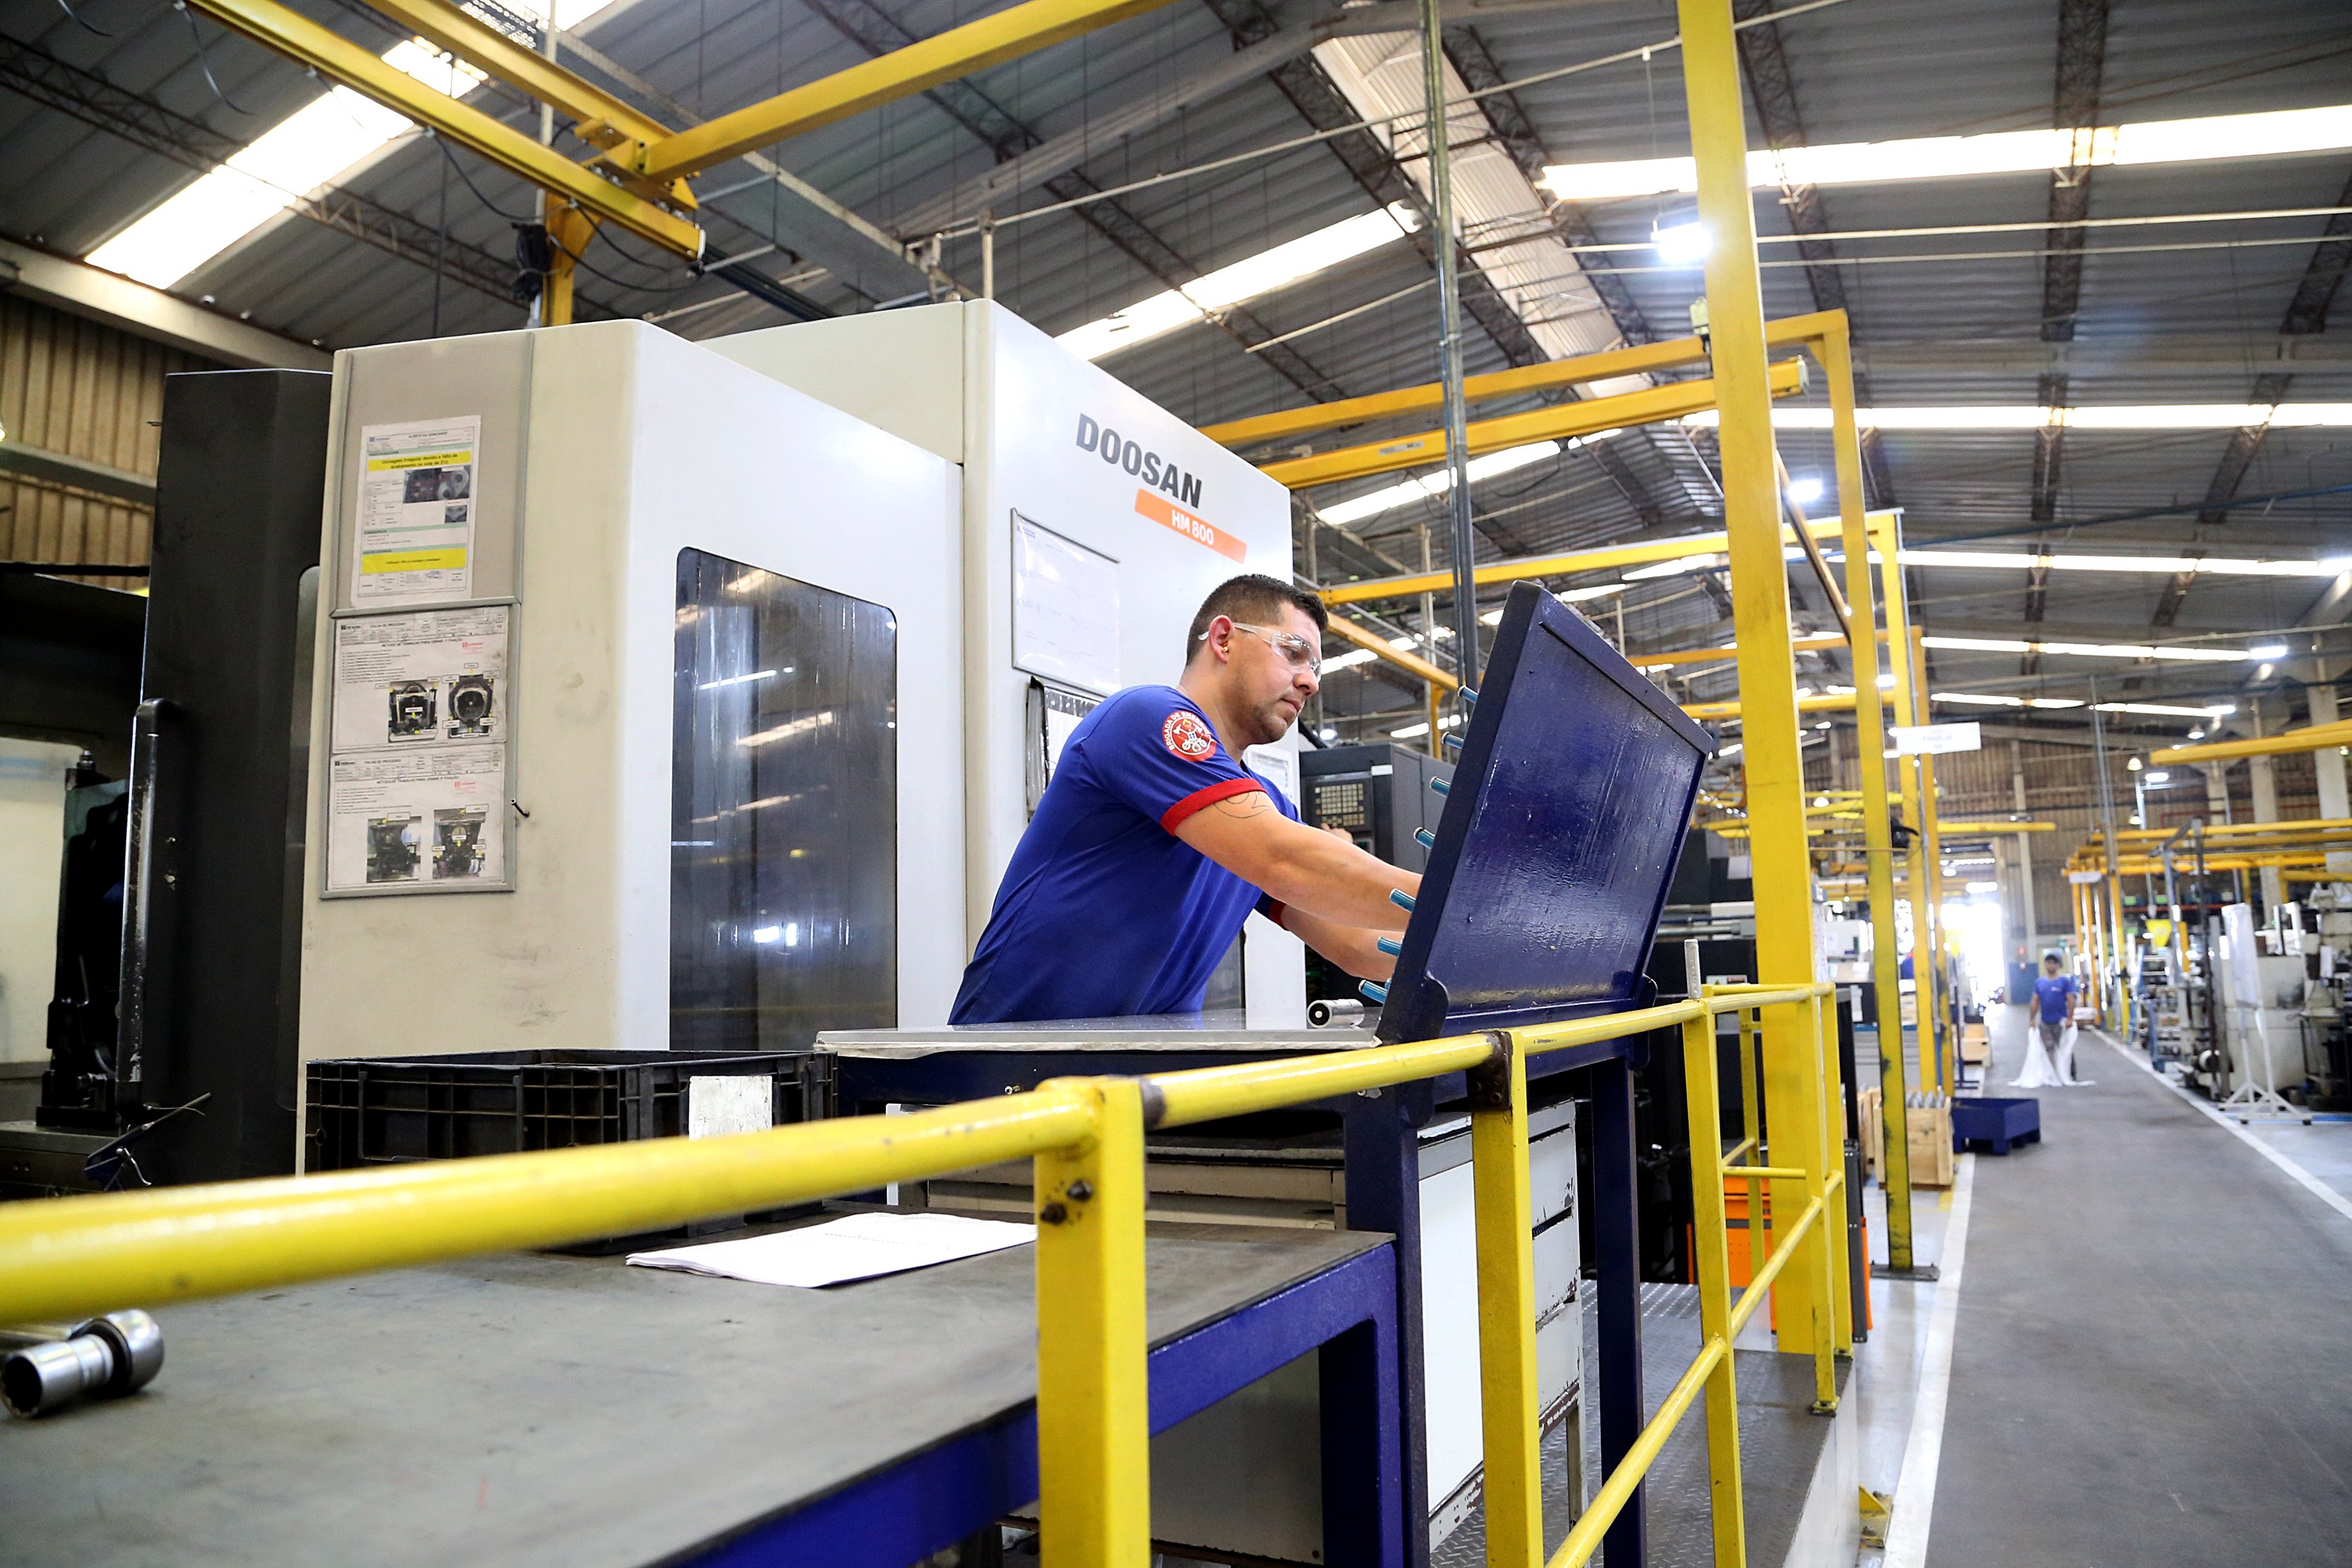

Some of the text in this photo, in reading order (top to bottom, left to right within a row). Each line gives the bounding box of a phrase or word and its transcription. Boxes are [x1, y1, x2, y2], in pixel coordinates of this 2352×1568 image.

[1076, 412, 1202, 509] DOOSAN
[1171, 509, 1214, 546] HM 800
[1163, 720, 1176, 751] BRIGADA
[1171, 712, 1181, 720] DE
